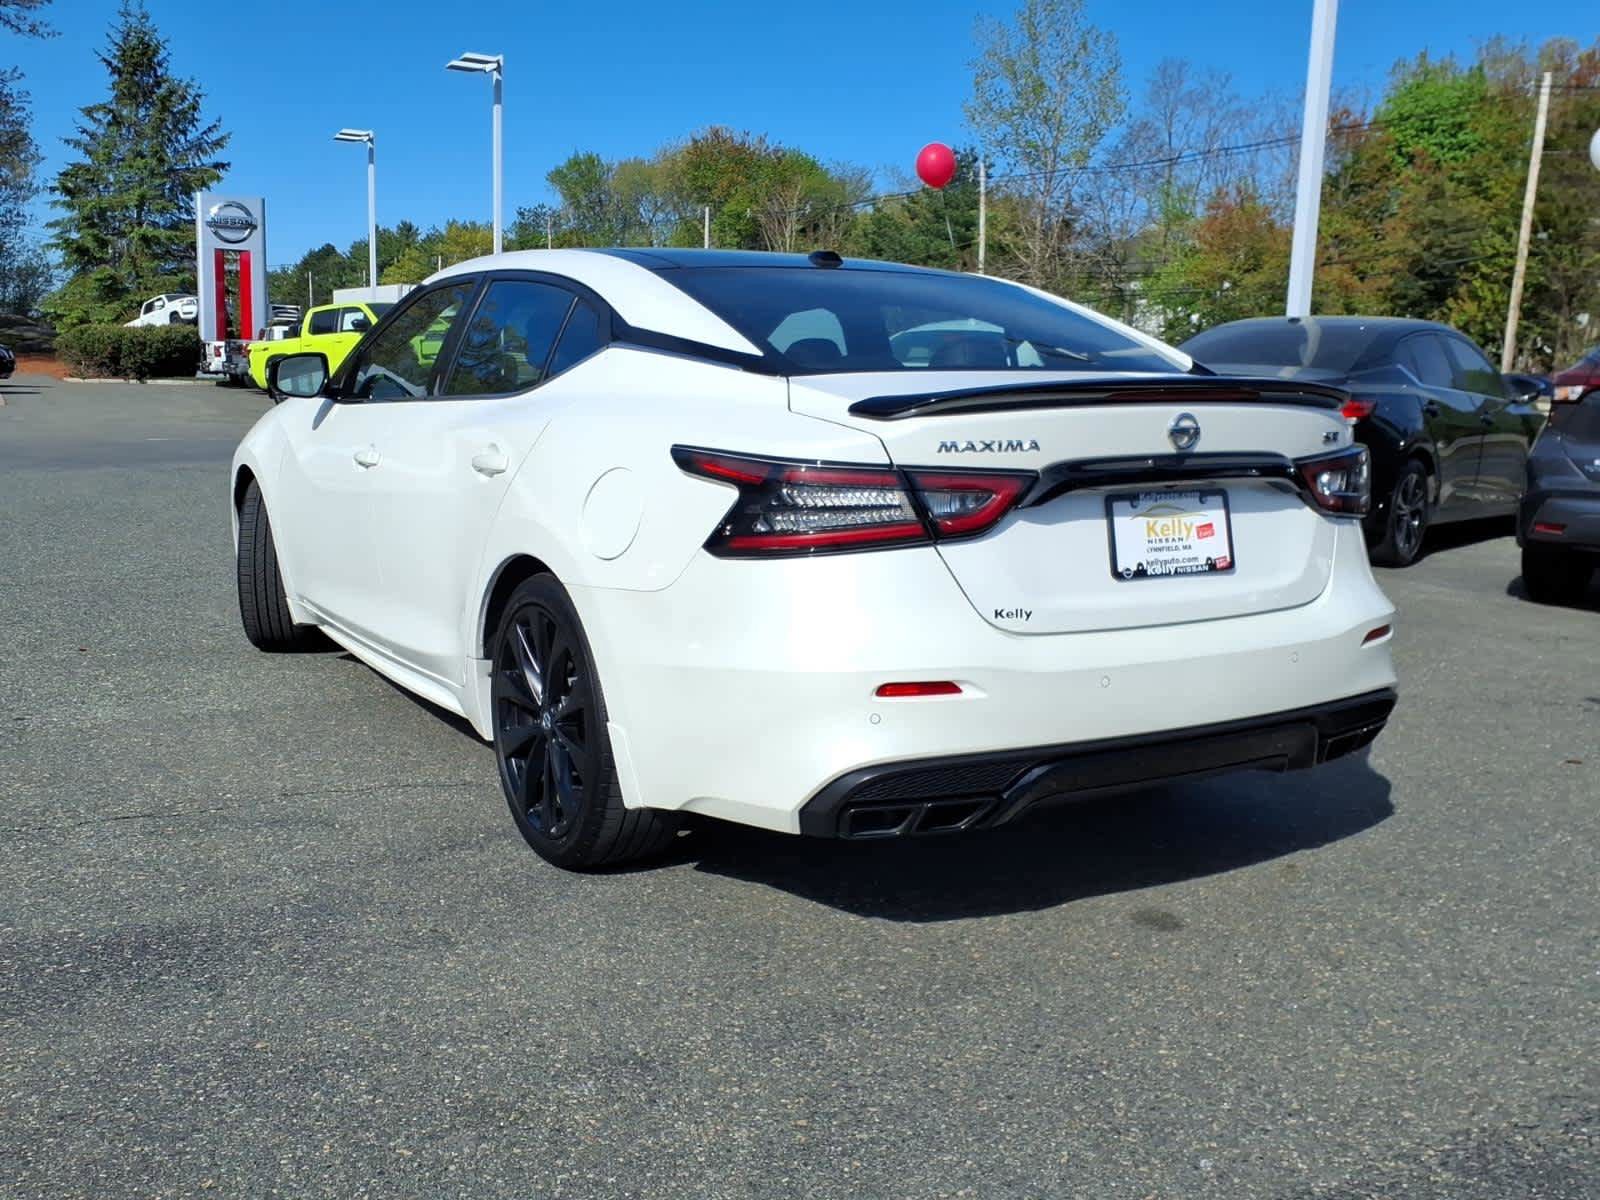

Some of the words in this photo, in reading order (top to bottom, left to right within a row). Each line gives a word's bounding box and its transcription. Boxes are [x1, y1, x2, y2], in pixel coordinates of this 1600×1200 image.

[210, 216, 253, 225] NISSAN
[937, 439, 1041, 453] MAXIMA
[1146, 518, 1194, 541] Kelly
[1146, 564, 1176, 576] Kelly
[1177, 564, 1210, 574] NISSAN
[994, 608, 1033, 621] Kelly
